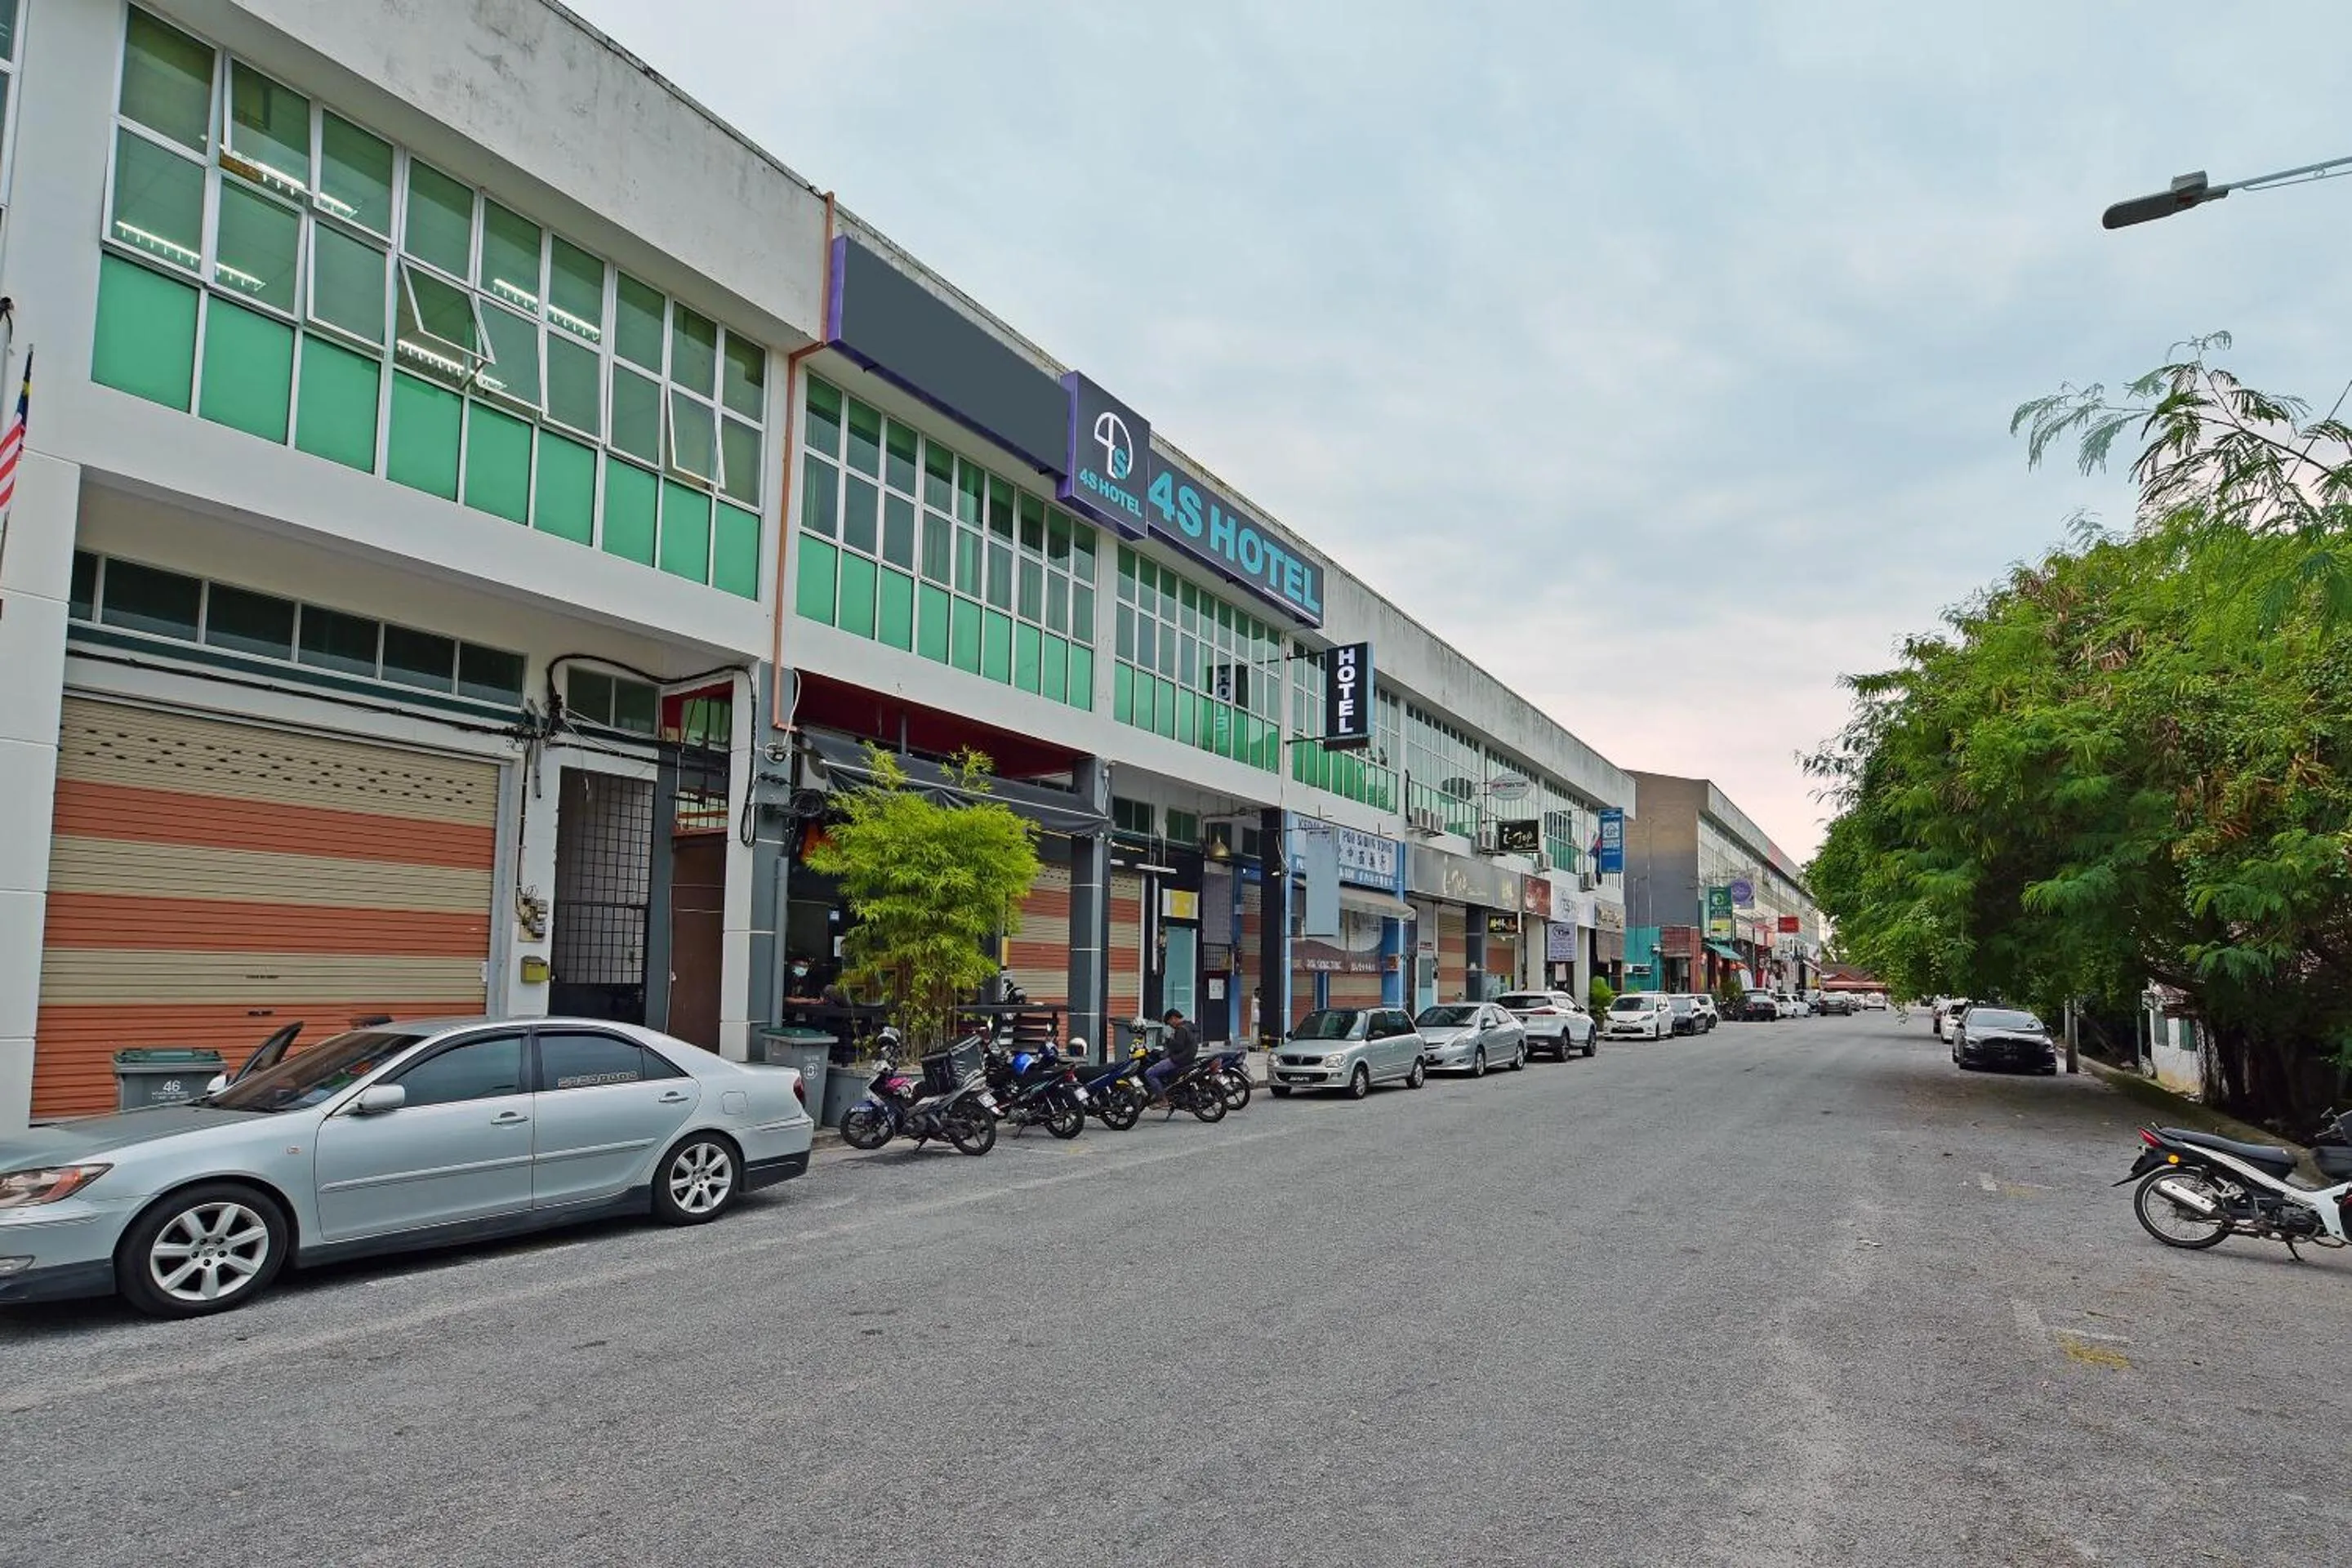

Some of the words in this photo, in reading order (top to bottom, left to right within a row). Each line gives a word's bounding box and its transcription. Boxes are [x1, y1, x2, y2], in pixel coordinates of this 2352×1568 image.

[1080, 468, 1098, 490] 4S
[1098, 477, 1143, 518] HOTEL
[1148, 471, 1203, 538] 4S
[1210, 503, 1320, 612] HOTEL
[1338, 648, 1356, 734] HOTEL
[163, 1080, 181, 1093] 46
